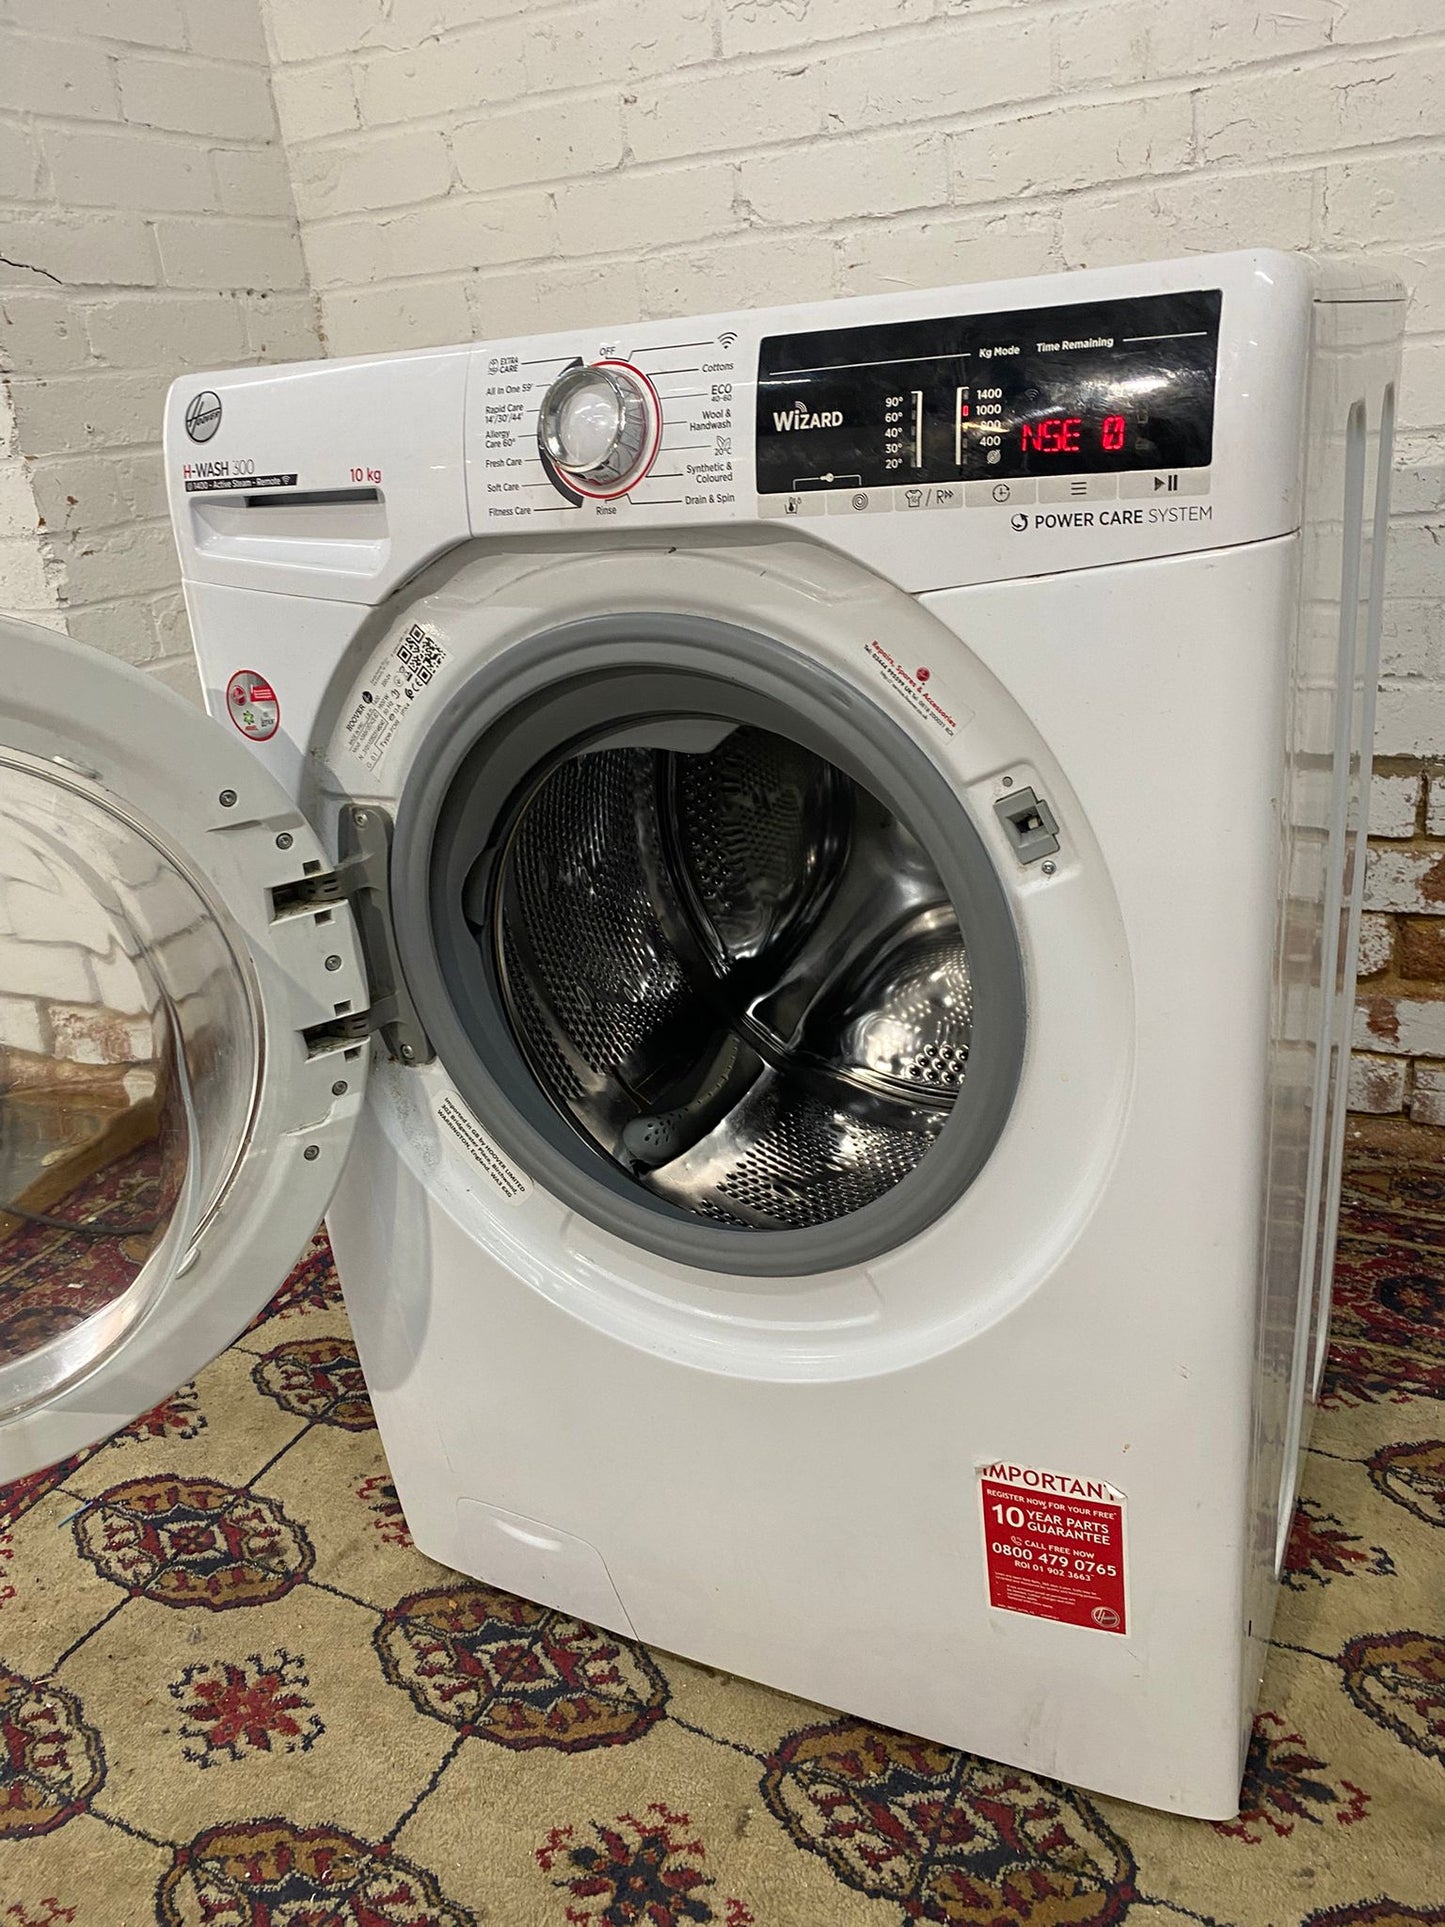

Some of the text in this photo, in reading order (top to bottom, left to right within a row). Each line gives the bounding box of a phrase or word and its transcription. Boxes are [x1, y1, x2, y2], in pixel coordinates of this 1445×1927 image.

[599, 346, 616, 356] OFF
[1036, 337, 1114, 353] Time Remaining
[979, 346, 1020, 359] Kg Mode
[500, 357, 518, 366] EXTRA
[702, 362, 734, 373] Cottons
[500, 365, 518, 373] CARE
[486, 387, 496, 396] All
[505, 385, 521, 394] One
[711, 383, 732, 395] ECO
[976, 388, 1002, 400] 1400
[711, 394, 732, 402] 40-60
[885, 396, 903, 408] 90°
[485, 403, 524, 415] Rapid Care
[702, 408, 732, 419] Wool &
[975, 404, 1001, 415] 1000
[884, 412, 903, 423] 60°
[689, 420, 732, 431] Handwash
[485, 430, 510, 440] Allergy
[884, 427, 903, 438] 40°
[1021, 418, 1081, 452] NSE
[485, 440, 501, 449] Care
[979, 435, 1001, 447] 400
[885, 443, 903, 454] 30°
[183, 458, 254, 479] H-WASH 300
[485, 458, 522, 468] Fresh Care
[686, 462, 732, 475] Synthetic &
[885, 458, 903, 469] 20°
[350, 467, 381, 484] 10 kg
[695, 472, 733, 483] Coloured
[487, 483, 519, 493] Soft Care
[685, 493, 735, 505] Drain & Spin
[488, 506, 531, 517] Fitness Care
[596, 505, 617, 515] Rinse
[1035, 505, 1213, 529] POWER CARE SYSTEM
[896, 665, 917, 687] Spares
[923, 693, 957, 727] Accessories
[346, 703, 365, 731] HOOVER
[450, 1114, 478, 1147] Bridgewater
[444, 1097, 467, 1122] Imported
[478, 1137, 485, 1146] by
[485, 1145, 506, 1168] HOOVER
[504, 1168, 525, 1191] LIMITED
[983, 1464, 1115, 1501] IMPORTAN
[986, 1488, 1025, 1504] REGISTER
[1026, 1497, 1047, 1508] NOW
[1048, 1501, 1066, 1511] FOR
[1067, 1505, 1091, 1516] YOUR
[992, 1503, 1109, 1534] 10 YEAR PARTS
[1027, 1521, 1111, 1545] GUARANTEE
[1024, 1539, 1095, 1559] CALL FREE NOW
[992, 1542, 1117, 1577] 0800 479 0765
[1014, 1560, 1030, 1569] ROI
[1032, 1563, 1044, 1572] 01
[1047, 1566, 1064, 1577] 902
